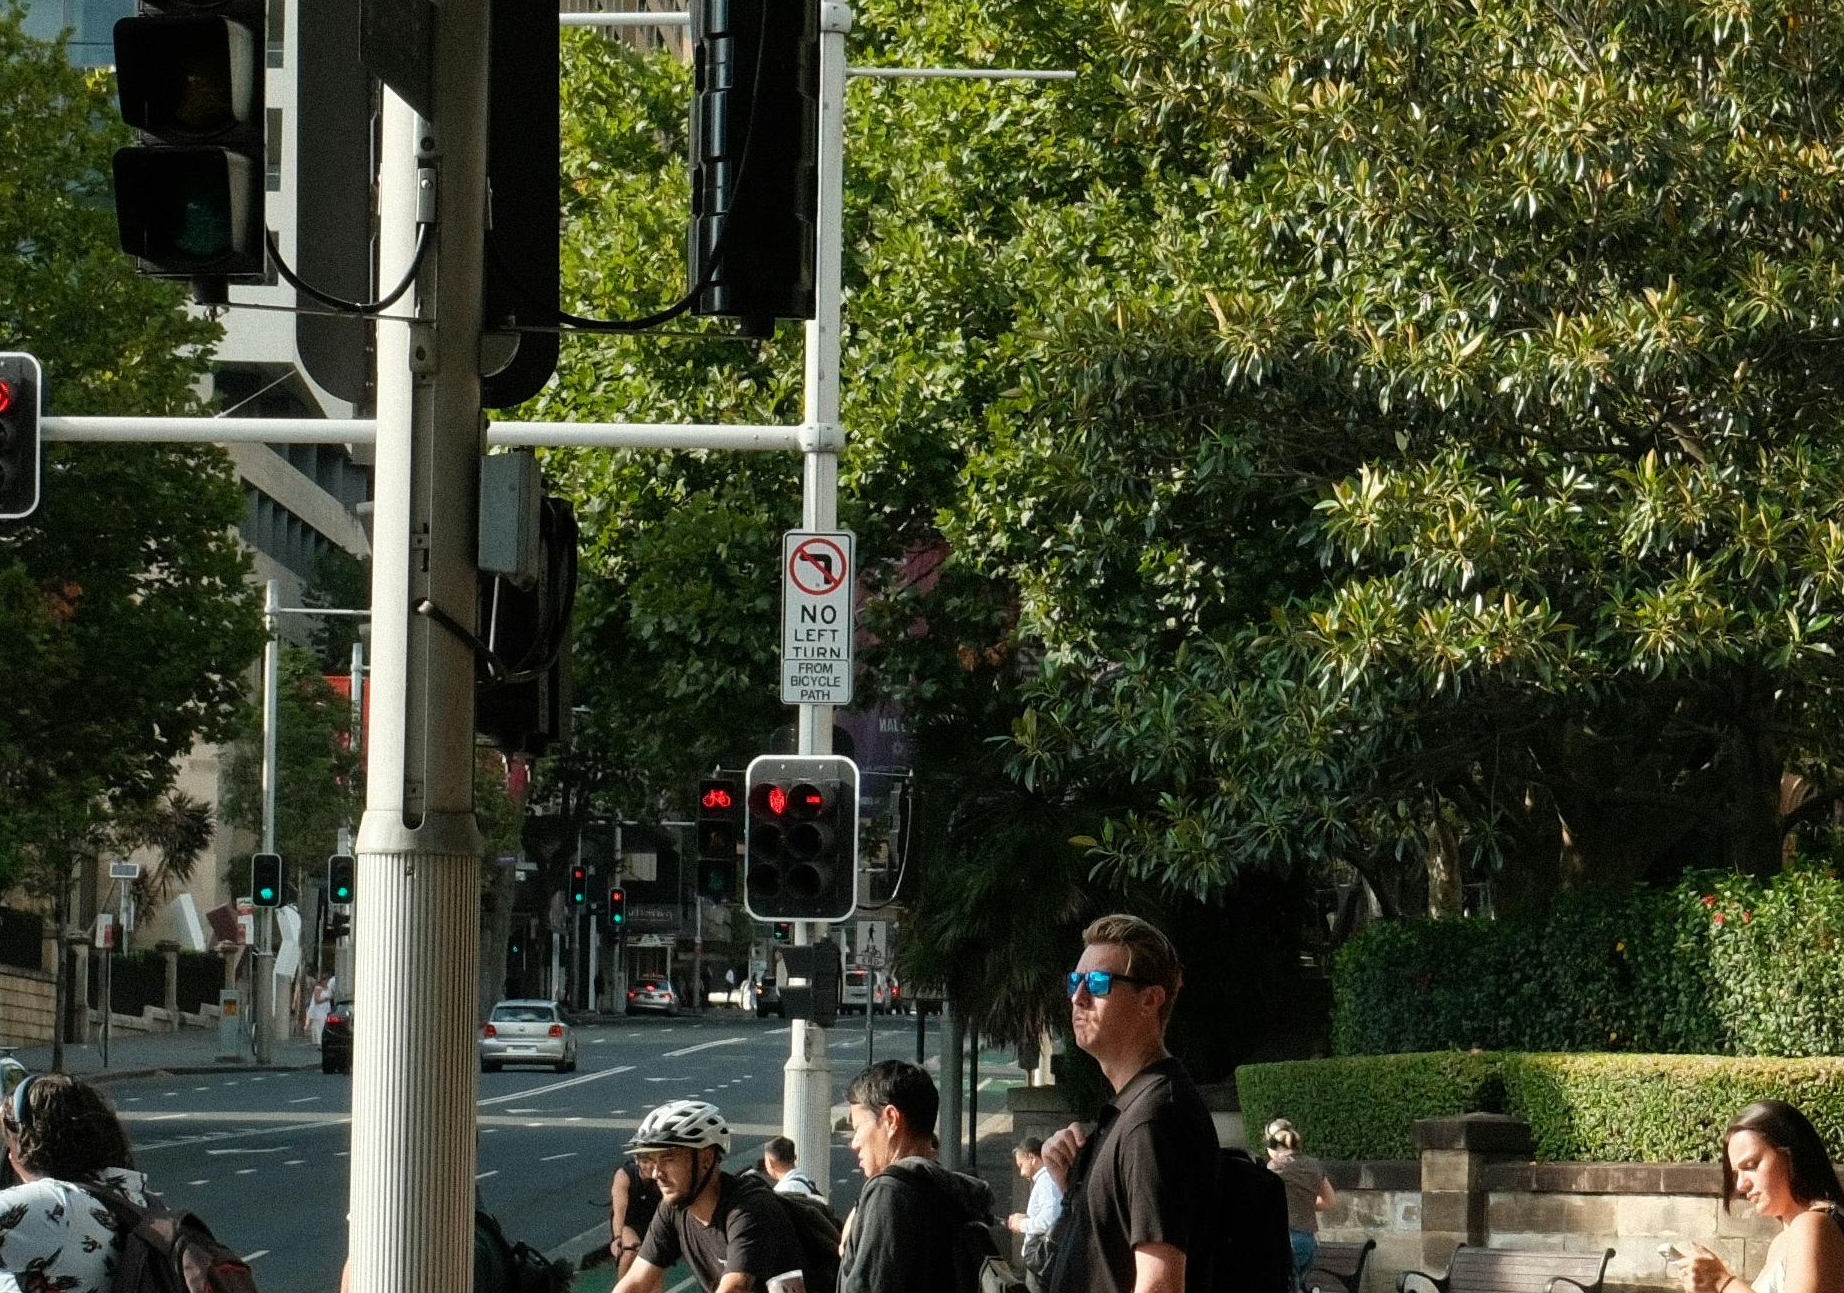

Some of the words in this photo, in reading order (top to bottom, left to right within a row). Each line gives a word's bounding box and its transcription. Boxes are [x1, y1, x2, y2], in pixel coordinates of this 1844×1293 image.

[800, 604, 837, 625] NO
[794, 628, 840, 643] LEFT
[792, 646, 842, 659] TURN
[798, 662, 834, 675] FROM
[790, 675, 842, 689] BICYCLE
[800, 688, 831, 701] PATH
